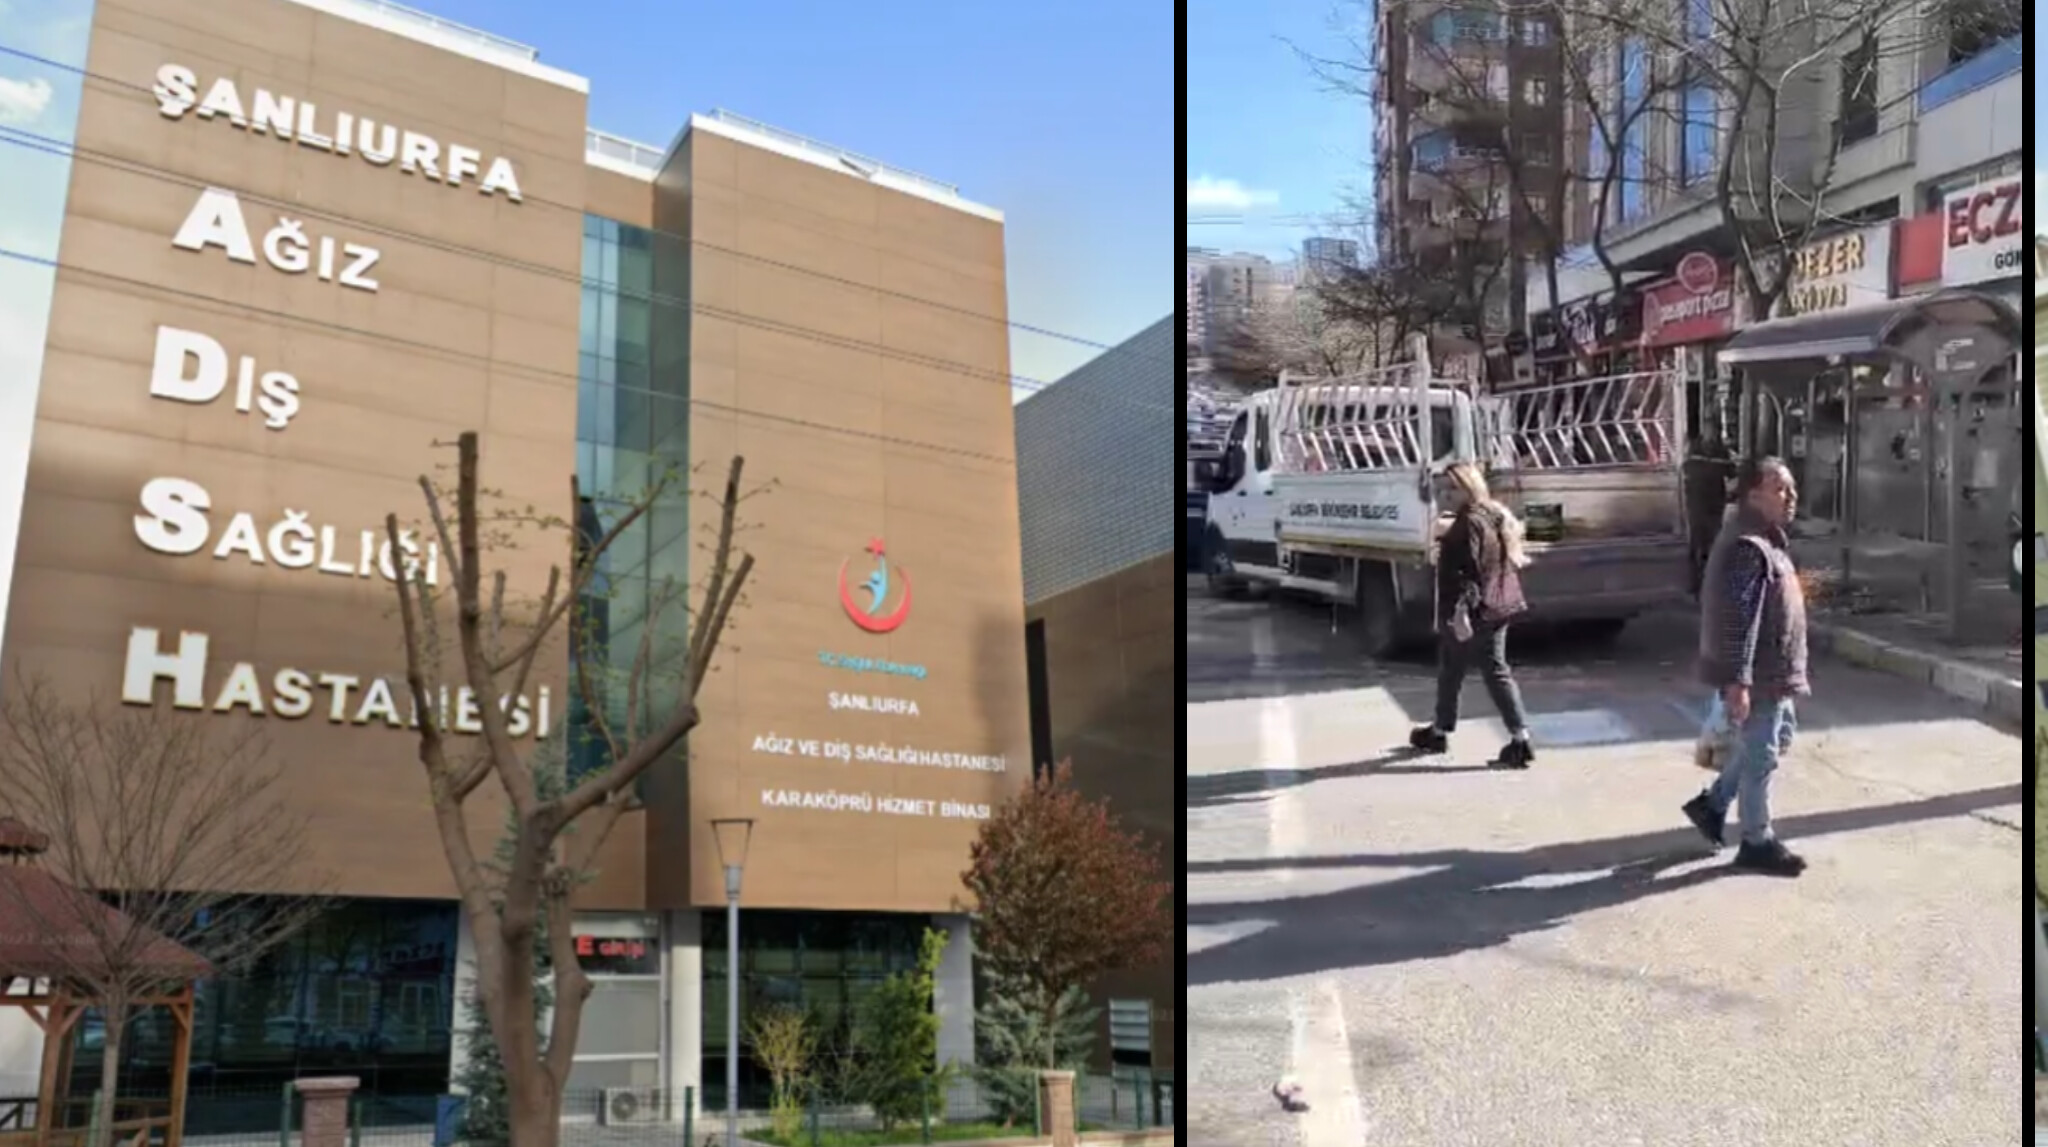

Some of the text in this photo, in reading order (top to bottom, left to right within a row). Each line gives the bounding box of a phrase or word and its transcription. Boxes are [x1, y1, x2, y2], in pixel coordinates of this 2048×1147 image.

[152, 63, 524, 202] ŞANLIURFA
[172, 186, 380, 291] AĞIZ
[1948, 183, 2022, 248] ECZ
[133, 476, 438, 586] SAĞLIĞI
[828, 691, 920, 716] ŞANLIURFA
[753, 731, 793, 755] AĞIZ
[799, 739, 820, 757] VE
[919, 753, 1006, 772] HASTANESİ
[761, 788, 872, 812] KARAKÖPRÜ
